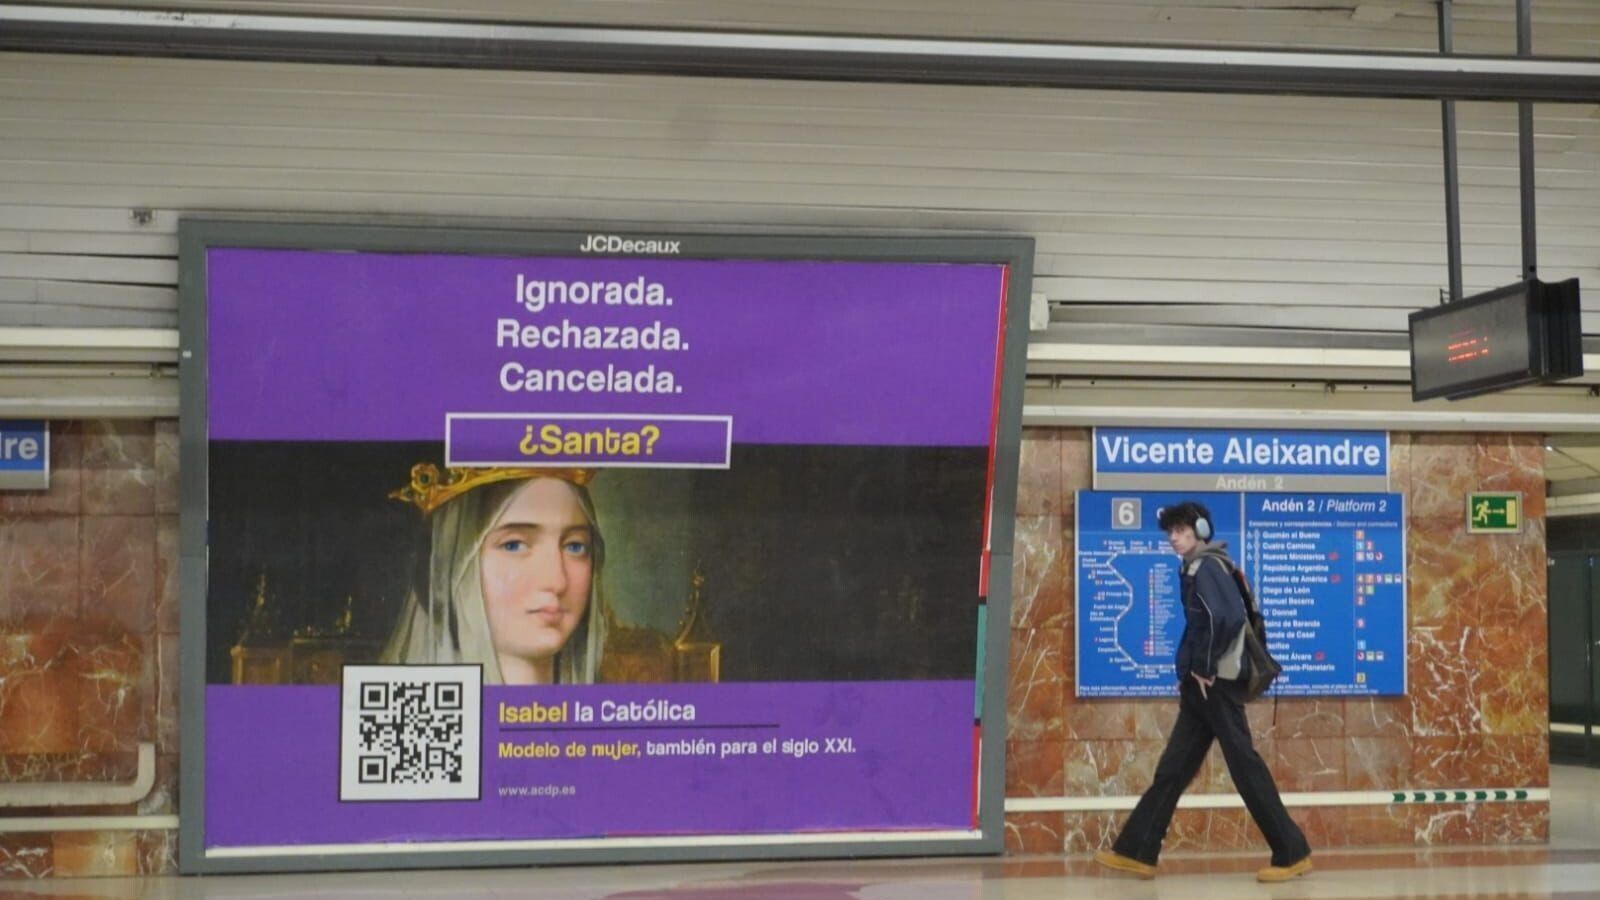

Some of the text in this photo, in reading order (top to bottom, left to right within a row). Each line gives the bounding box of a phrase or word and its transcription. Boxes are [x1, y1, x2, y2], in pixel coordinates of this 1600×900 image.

[580, 235, 680, 254] JCDecaux
[516, 274, 673, 312] Ignorada.
[497, 318, 690, 350] Rechazada.
[499, 362, 683, 393] Cancelada.
[519, 424, 660, 455] ¿Santa?
[1101, 436, 1381, 466] Vicente Aleixandre
[1215, 475, 1285, 490] Andén 2
[1118, 502, 1135, 526] 6
[1262, 498, 1304, 512] Andén
[1307, 501, 1316, 513] 2
[1326, 499, 1376, 513] Platform
[1378, 500, 1388, 513] 2
[499, 698, 696, 723] Isabel la Católica
[498, 737, 857, 760] Modelo de mujer, también para el siglo XXI.
[498, 784, 576, 798] www.acdp.es
